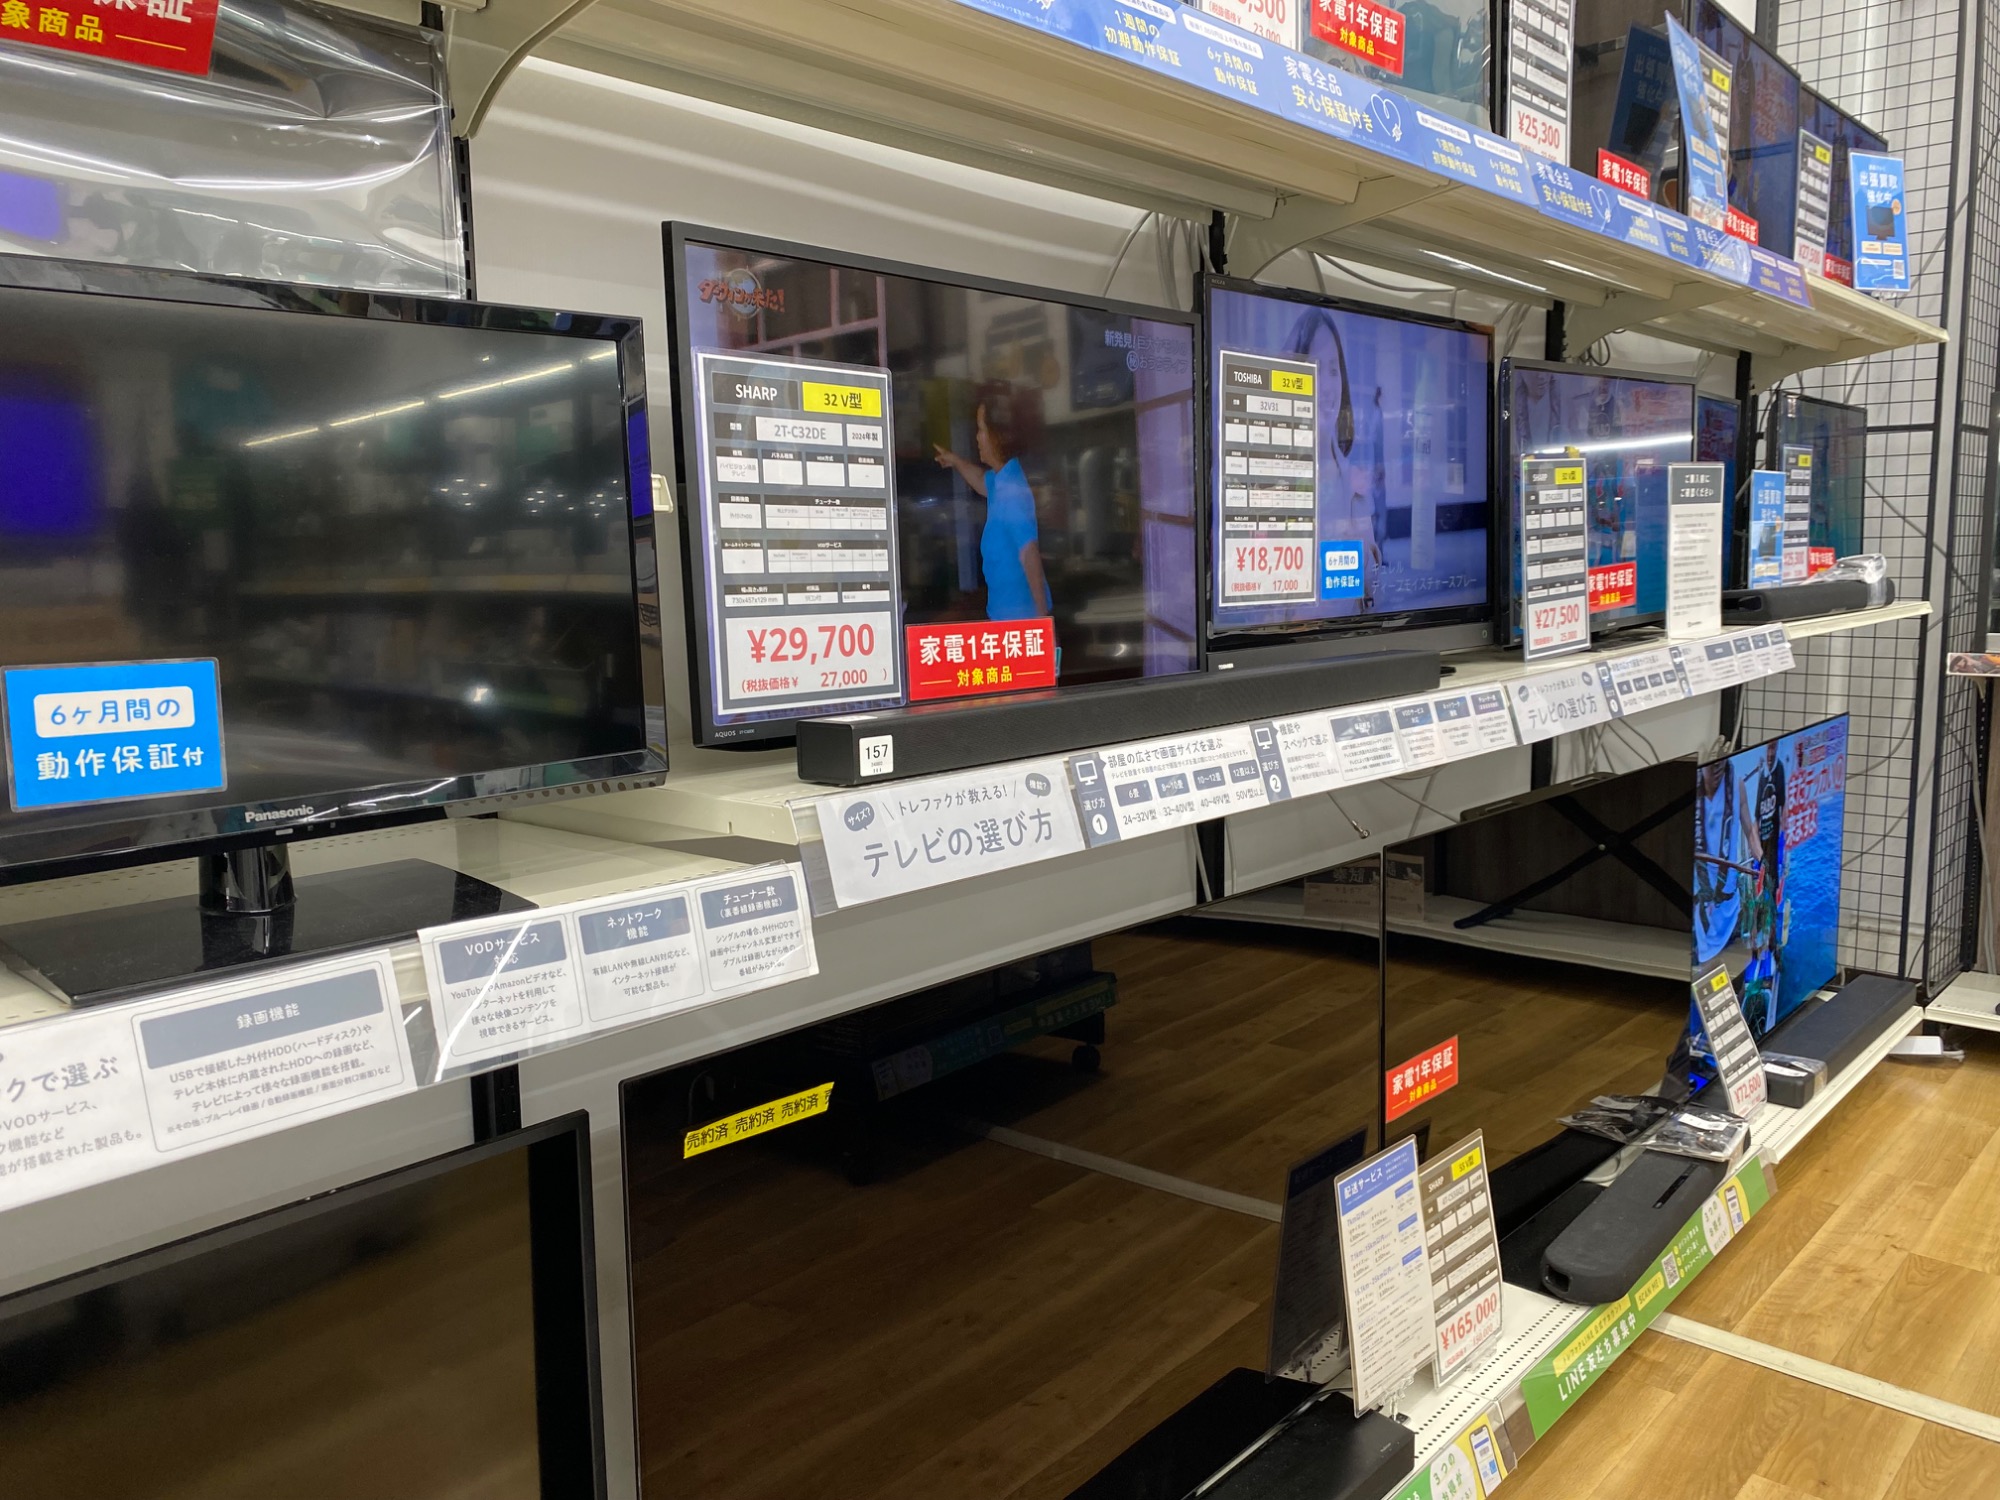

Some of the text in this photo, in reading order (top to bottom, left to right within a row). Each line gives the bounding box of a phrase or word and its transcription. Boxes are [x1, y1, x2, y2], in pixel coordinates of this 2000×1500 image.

[1114, 9, 1160, 39] 1週間の
[1103, 24, 1183, 68] 初期動作保証
[1339, 26, 1375, 56] 対象商品
[1206, 46, 1254, 75] 6ヶ月間の
[1213, 66, 1260, 97] 動作保証
[1283, 55, 1343, 97] 家電全品
[1291, 83, 1374, 134] 安心保証付き
[1517, 110, 1561, 150] ¥25,300
[1602, 158, 1649, 196] 家電1年保証
[735, 383, 778, 401] SHARP
[1233, 370, 1263, 385] TOSHIBA
[1282, 377, 1290, 388] 32
[823, 393, 838, 408] 32
[774, 424, 827, 440] 2T-C32DE
[1235, 545, 1304, 576] ¥18,700
[1328, 555, 1356, 567] 6ヶ月間の
[1272, 579, 1299, 593] 17,000
[1325, 575, 1361, 590] 動作保証付
[1535, 603, 1580, 630] ¥27,500
[748, 622, 875, 666] ¥29,700
[918, 628, 1046, 667] 家電1年保証
[820, 670, 868, 689] 27,000
[956, 665, 1014, 688] 対象商品
[51, 698, 181, 727] 6ヶ月間の
[1527, 692, 1597, 730] テレビの選び方
[714, 729, 737, 738] AQUOS
[36, 743, 205, 781] 動作保証付
[865, 743, 888, 760] 157
[1107, 738, 1224, 769] 部屋の広さで画面サイズを選ぶ
[245, 804, 314, 824] Panasonic
[899, 783, 1008, 817] トレファクが教える!
[1083, 797, 1106, 812] 選び方
[847, 806, 871, 826] サイズ?
[864, 807, 1053, 878] テレビの選び方
[723, 885, 776, 906] チューナー数
[607, 907, 662, 929] ネットワーク
[626, 925, 649, 941] 機能
[236, 1002, 301, 1030] 録画機能
[6, 1056, 120, 1104] クで選ぶ
[1392, 1045, 1454, 1096] 家電1年保証
[1734, 1072, 1762, 1104] ¥72,600
[0, 1100, 98, 1132] VODサービス、
[686, 1122, 729, 1151] 売約済
[735, 1106, 776, 1135] 売約済
[781, 1092, 820, 1119] 売約済
[1343, 1167, 1384, 1200] 配送サービス
[1638, 1287, 1651, 1305] SCAN
[1440, 1291, 1498, 1351] ¥165,000
[1558, 1311, 1637, 1402] LINE 友だち募集中
[1433, 1452, 1456, 1486] 3つの
